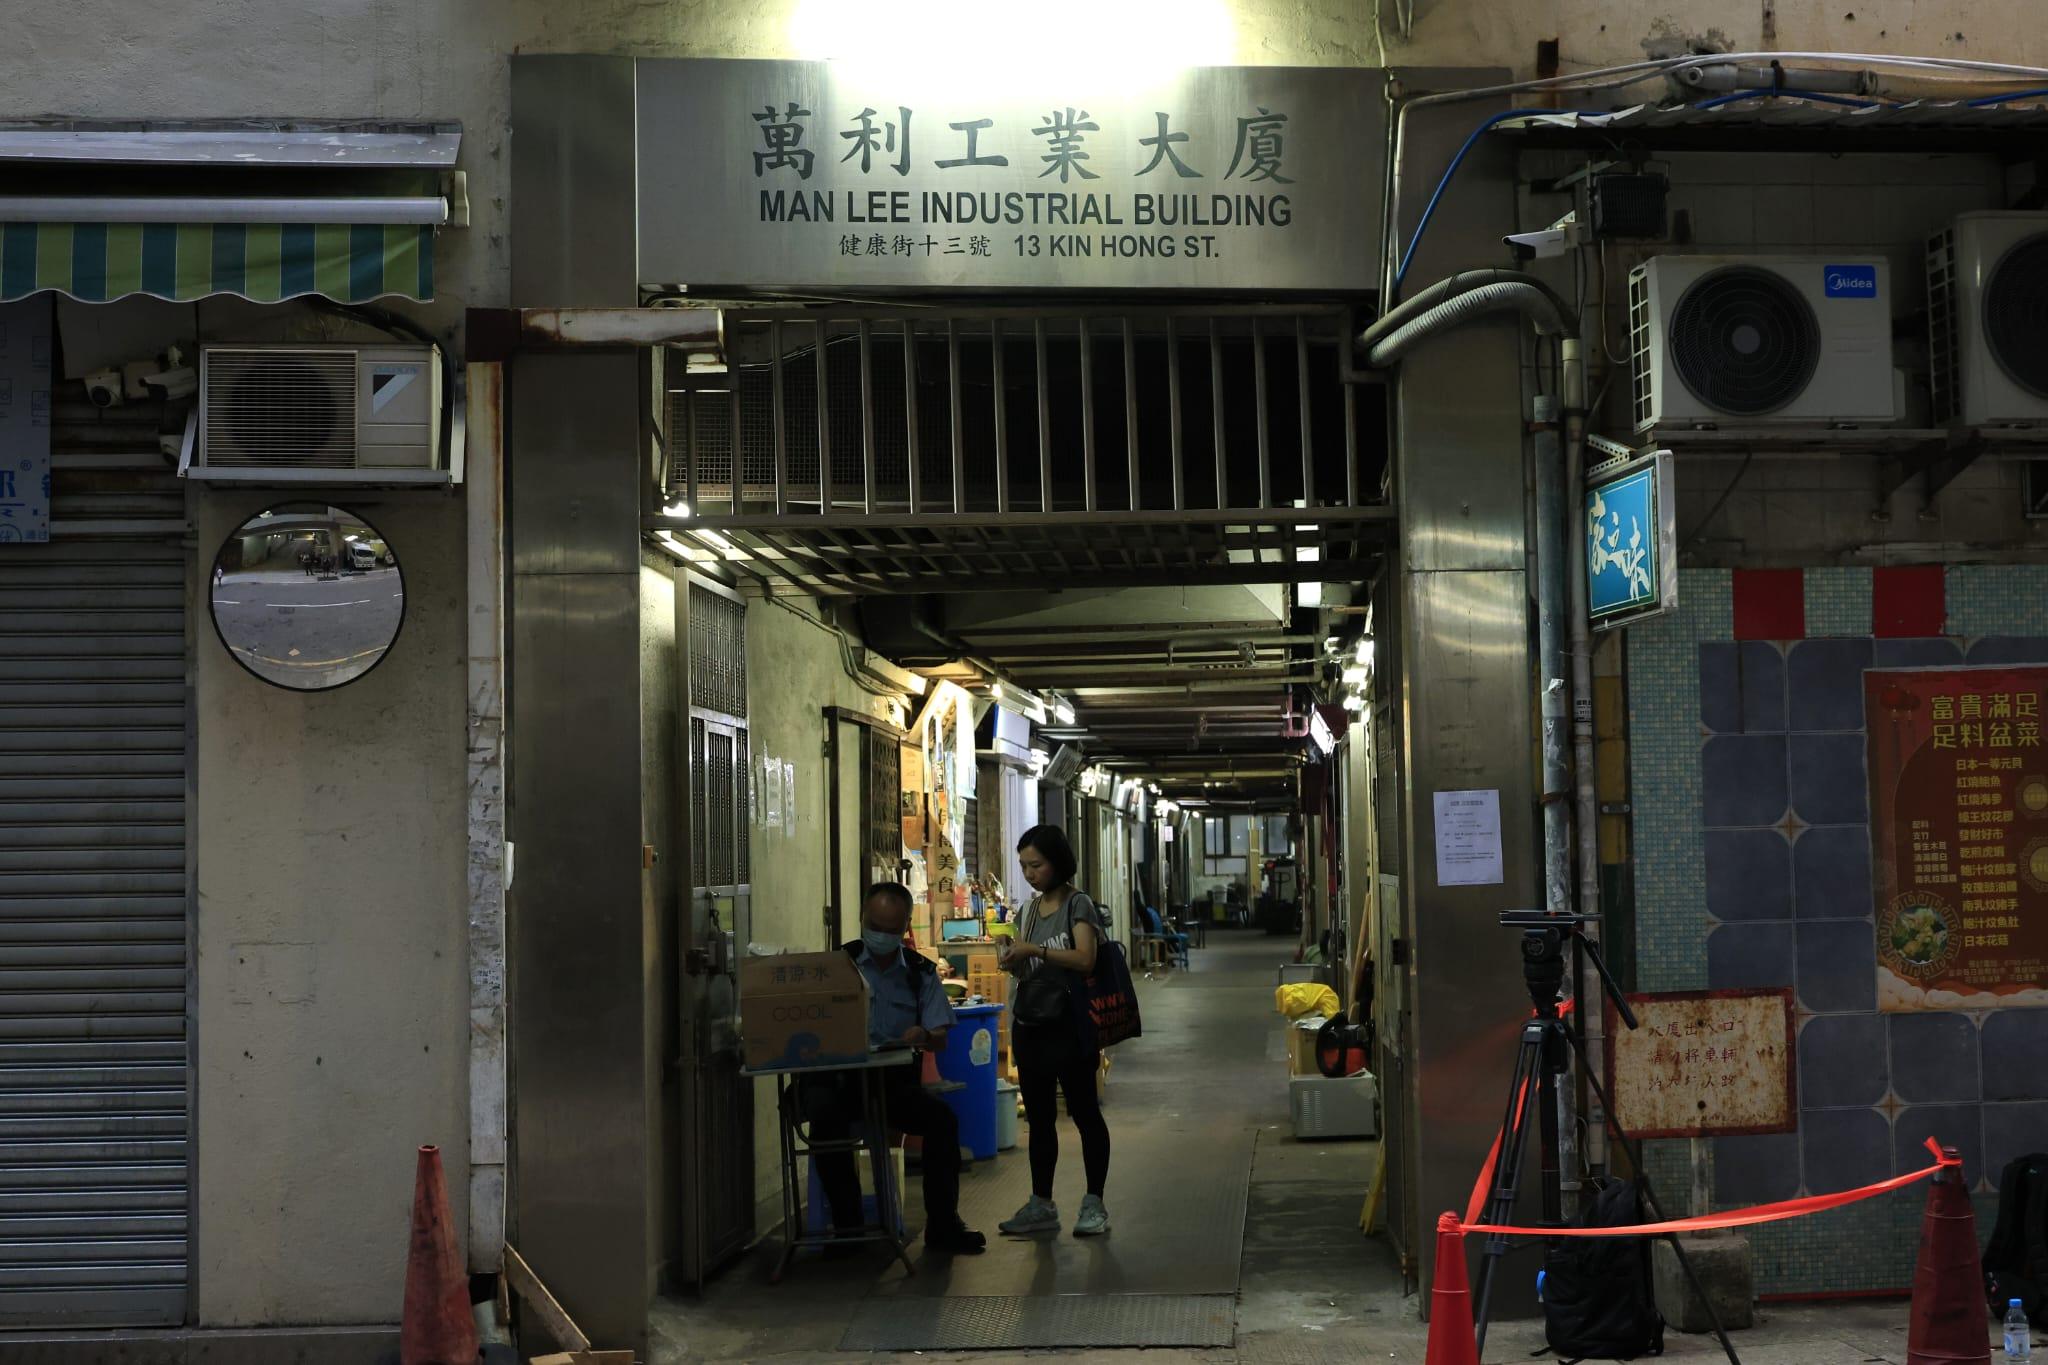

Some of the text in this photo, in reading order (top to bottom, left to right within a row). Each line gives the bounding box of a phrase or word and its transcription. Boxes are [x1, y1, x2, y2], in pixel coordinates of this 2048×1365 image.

[752, 102, 1297, 184] 萬利工業大廈
[760, 190, 1292, 227] MAN LEE INDUSTRIAL BUILDING
[839, 234, 992, 257] 健康街十三號
[1014, 235, 1219, 258] 13 KIN HONG ST.
[1828, 273, 1873, 291] Midea
[1931, 692, 2040, 721] 富貴滿足
[1932, 720, 2041, 750] 足料盆菜
